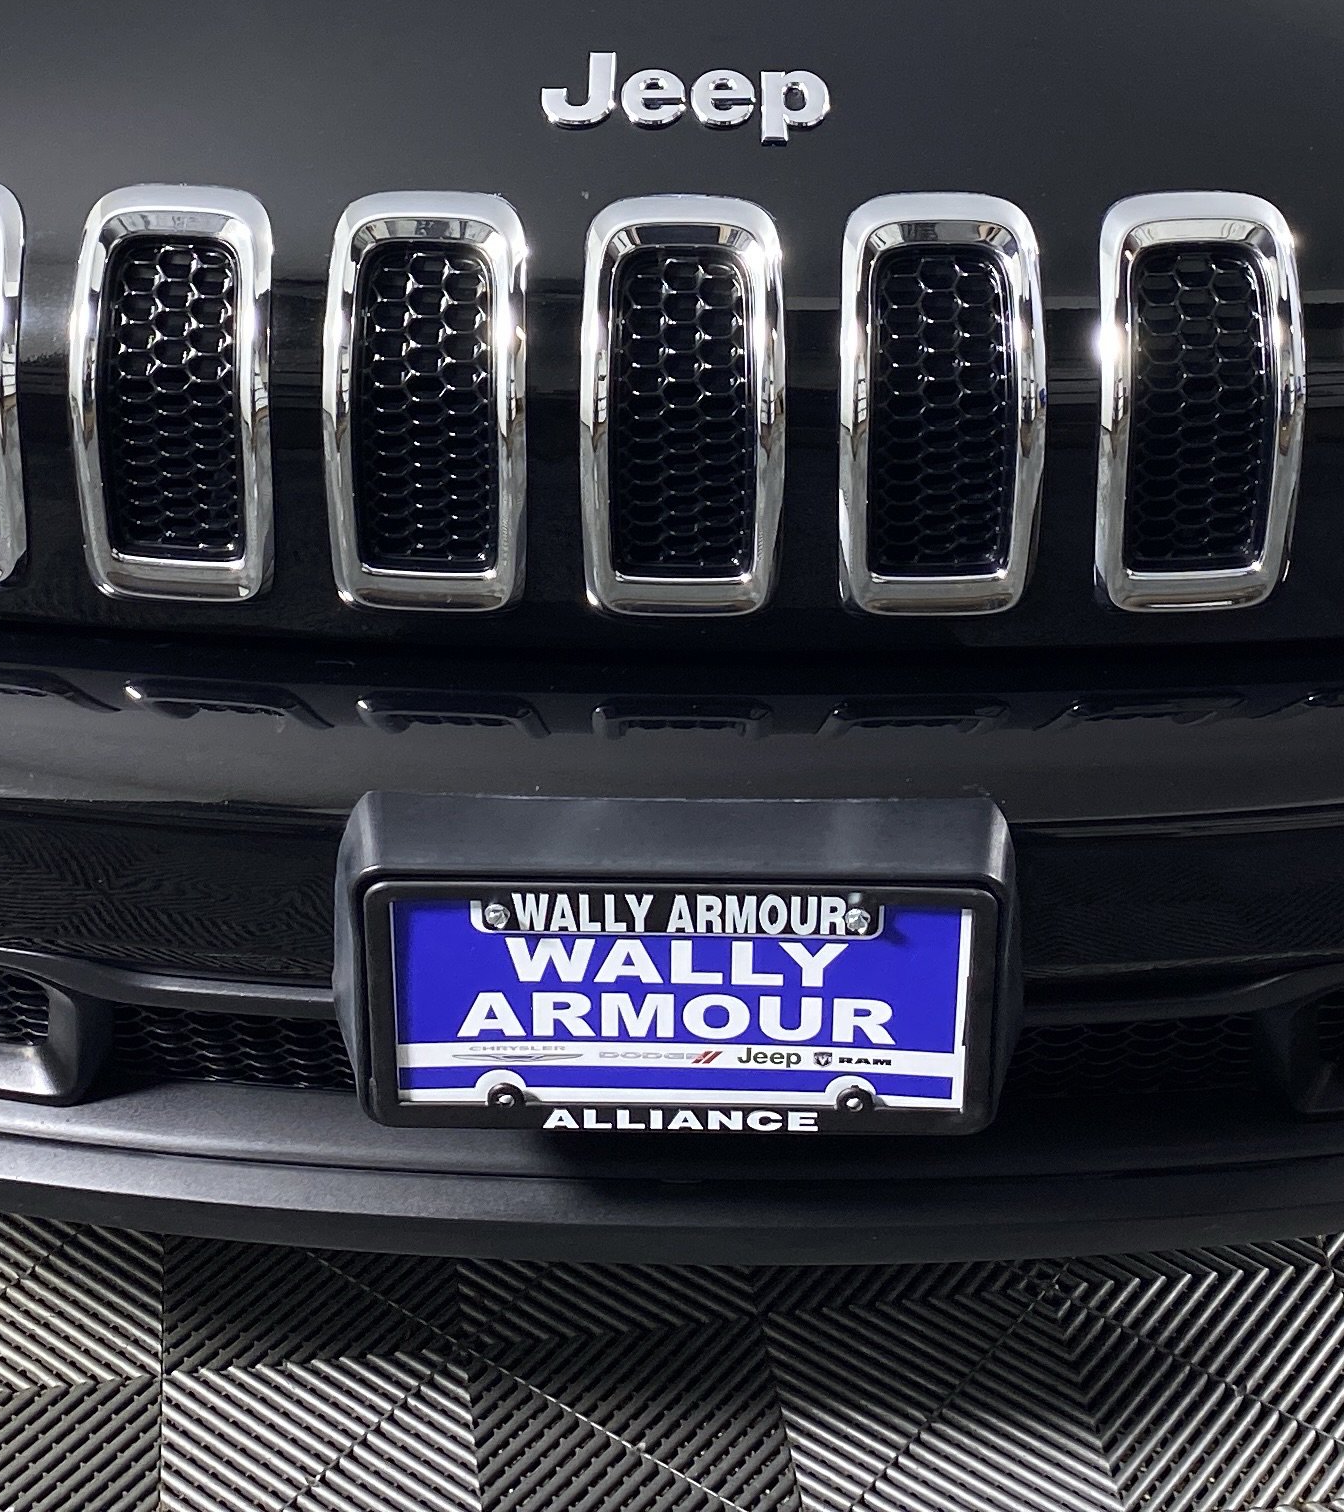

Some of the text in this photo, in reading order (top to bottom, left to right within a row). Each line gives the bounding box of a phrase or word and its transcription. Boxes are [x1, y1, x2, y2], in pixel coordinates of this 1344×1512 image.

[541, 51, 830, 146] Jeep
[511, 893, 847, 935] WALLY ARMOUR
[505, 937, 849, 987] WALLY
[457, 992, 895, 1045] ARMOUR
[737, 1047, 802, 1068] Jeep
[838, 1056, 892, 1066] RAM
[542, 1108, 819, 1132] ALLIANCE
